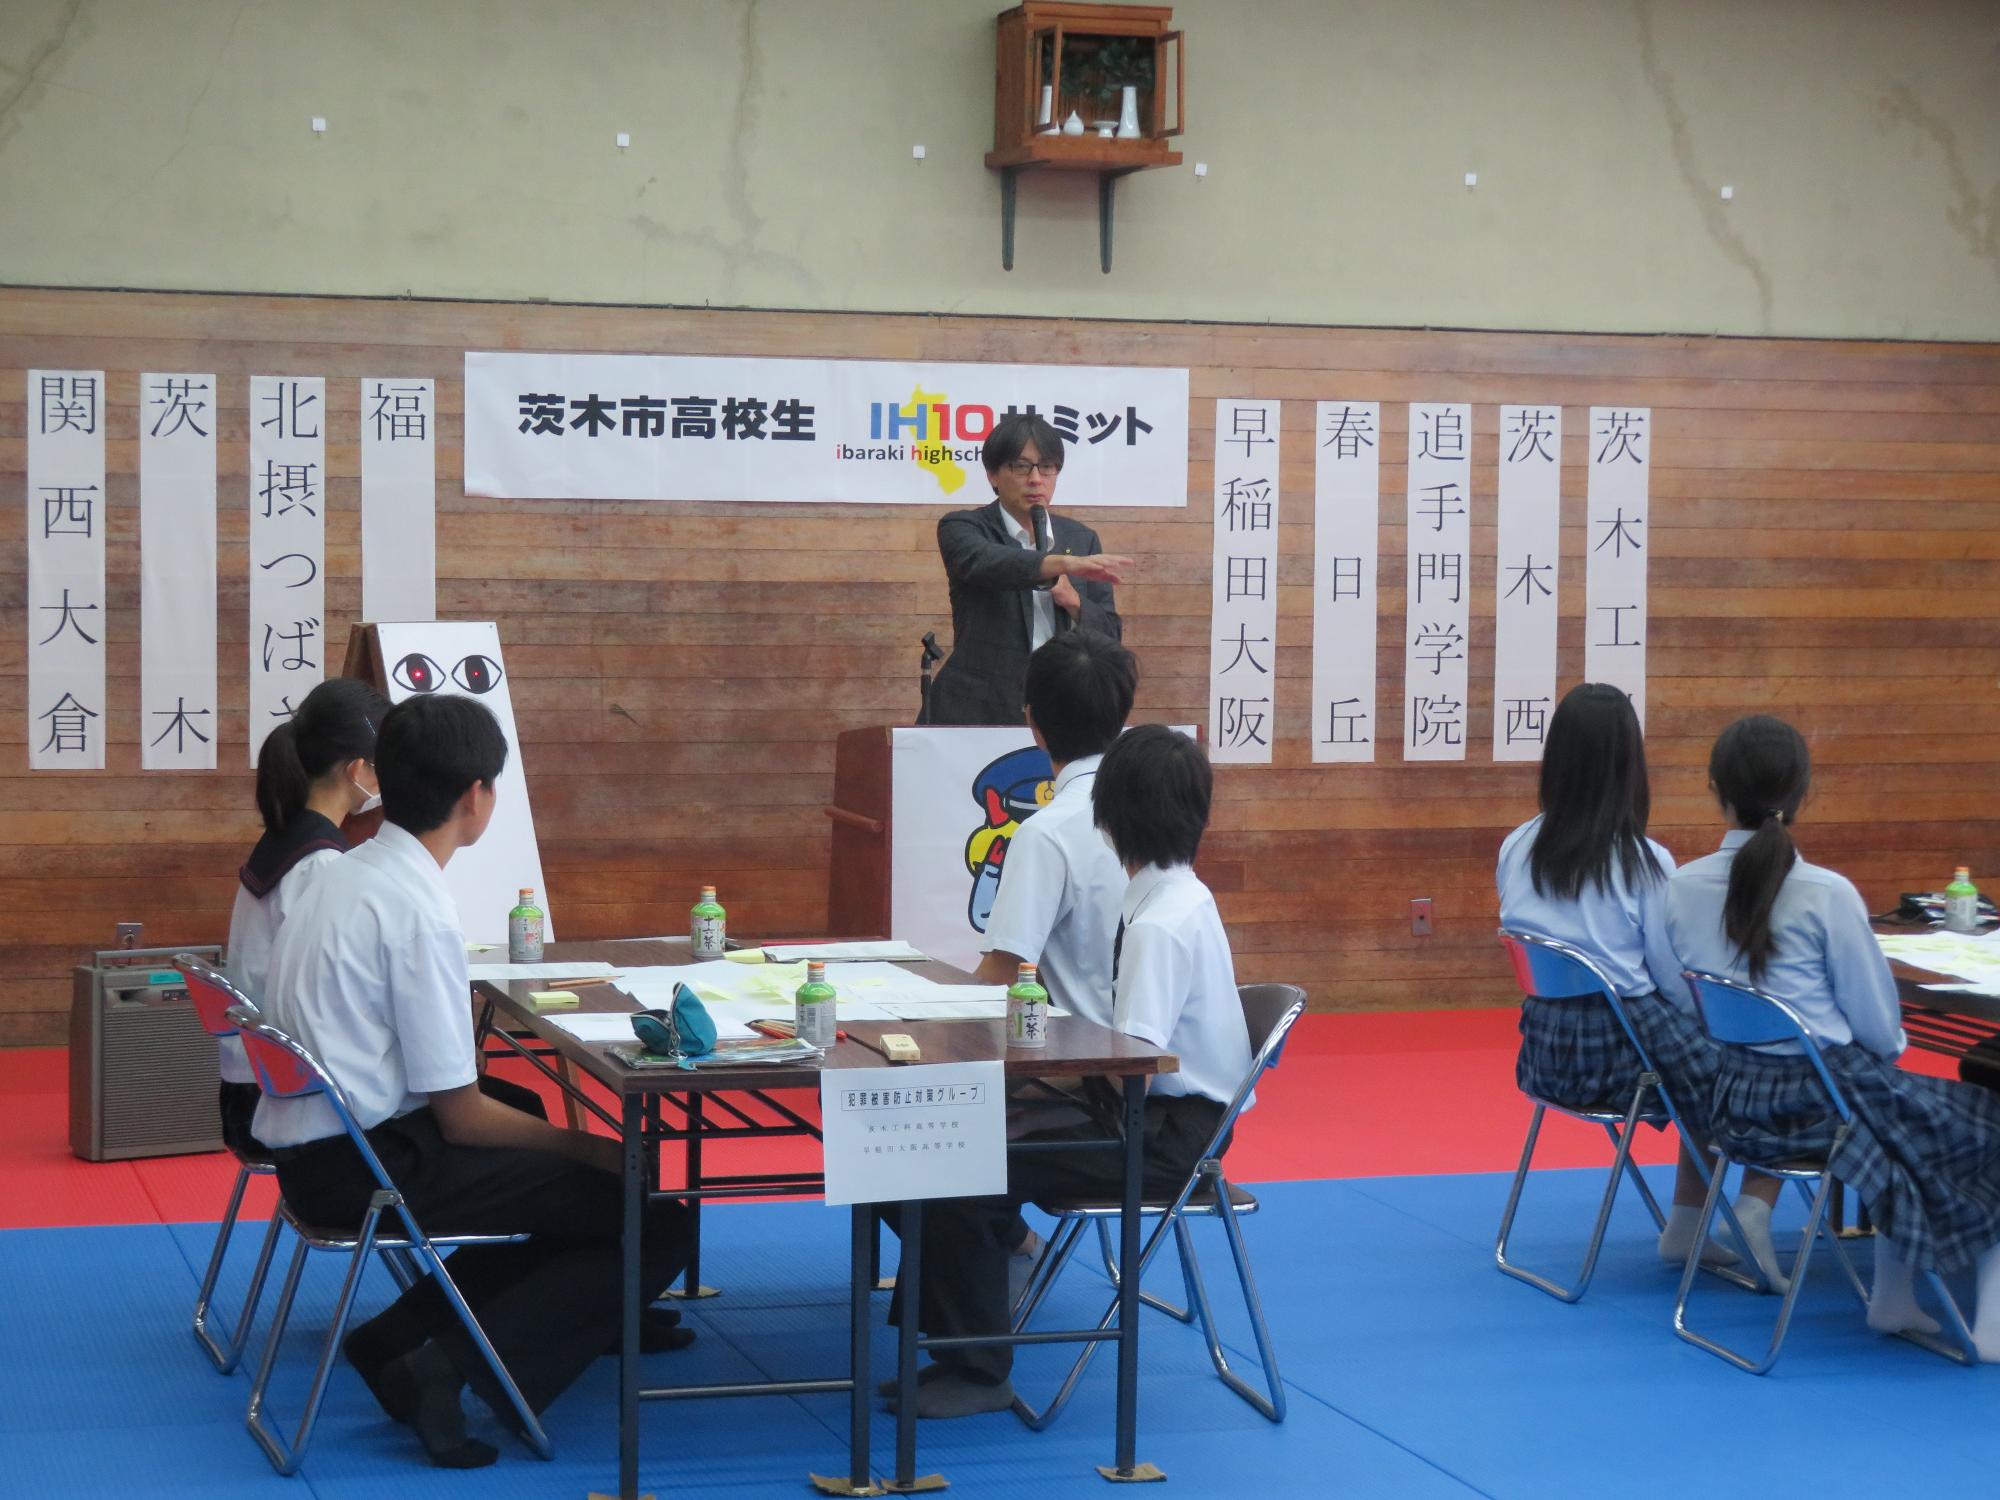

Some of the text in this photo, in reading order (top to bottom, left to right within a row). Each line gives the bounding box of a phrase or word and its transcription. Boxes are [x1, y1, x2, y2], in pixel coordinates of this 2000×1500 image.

[38, 376, 99, 754] 関西大倉
[149, 379, 210, 754] 茨木
[258, 382, 320, 716] 北摂つば
[518, 393, 816, 441] 茨木市高校生
[836, 444, 904, 461] ibaraki
[1218, 407, 1275, 748] 早稲田大阪
[1320, 406, 1374, 744] 春日丘
[1412, 408, 1466, 747] 追手門学院
[1502, 410, 1555, 745] 茨木西
[1594, 412, 1643, 697] 茨木工
[1024, 998, 1040, 1040] 十六茶
